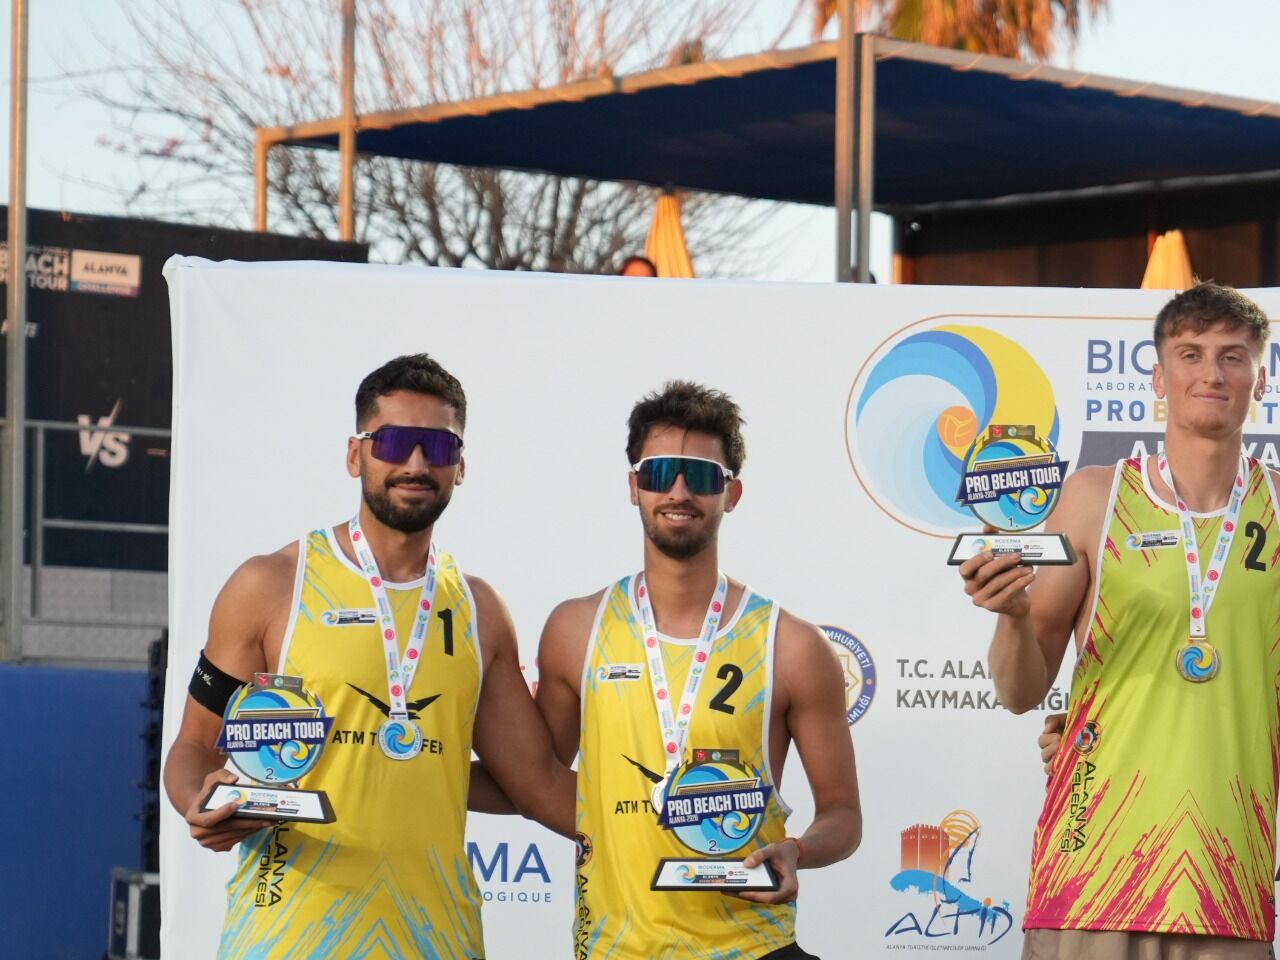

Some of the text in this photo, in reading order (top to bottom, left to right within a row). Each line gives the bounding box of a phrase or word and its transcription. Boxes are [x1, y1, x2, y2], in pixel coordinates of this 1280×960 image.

[1086, 400, 1146, 422] PRO
[77, 413, 132, 469] VS
[965, 466, 1061, 493] PRO BEACH TOUR
[1244, 521, 1267, 572] 2
[437, 608, 454, 656] 1
[896, 659, 934, 679] T.C.
[709, 663, 743, 715] 2
[226, 721, 325, 741] PRO BEACH TOUR
[332, 730, 364, 745] ATM
[615, 800, 639, 814] ATM
[667, 800, 692, 817] PRO
[694, 795, 732, 814] BEACH
[733, 792, 764, 809] TOUR
